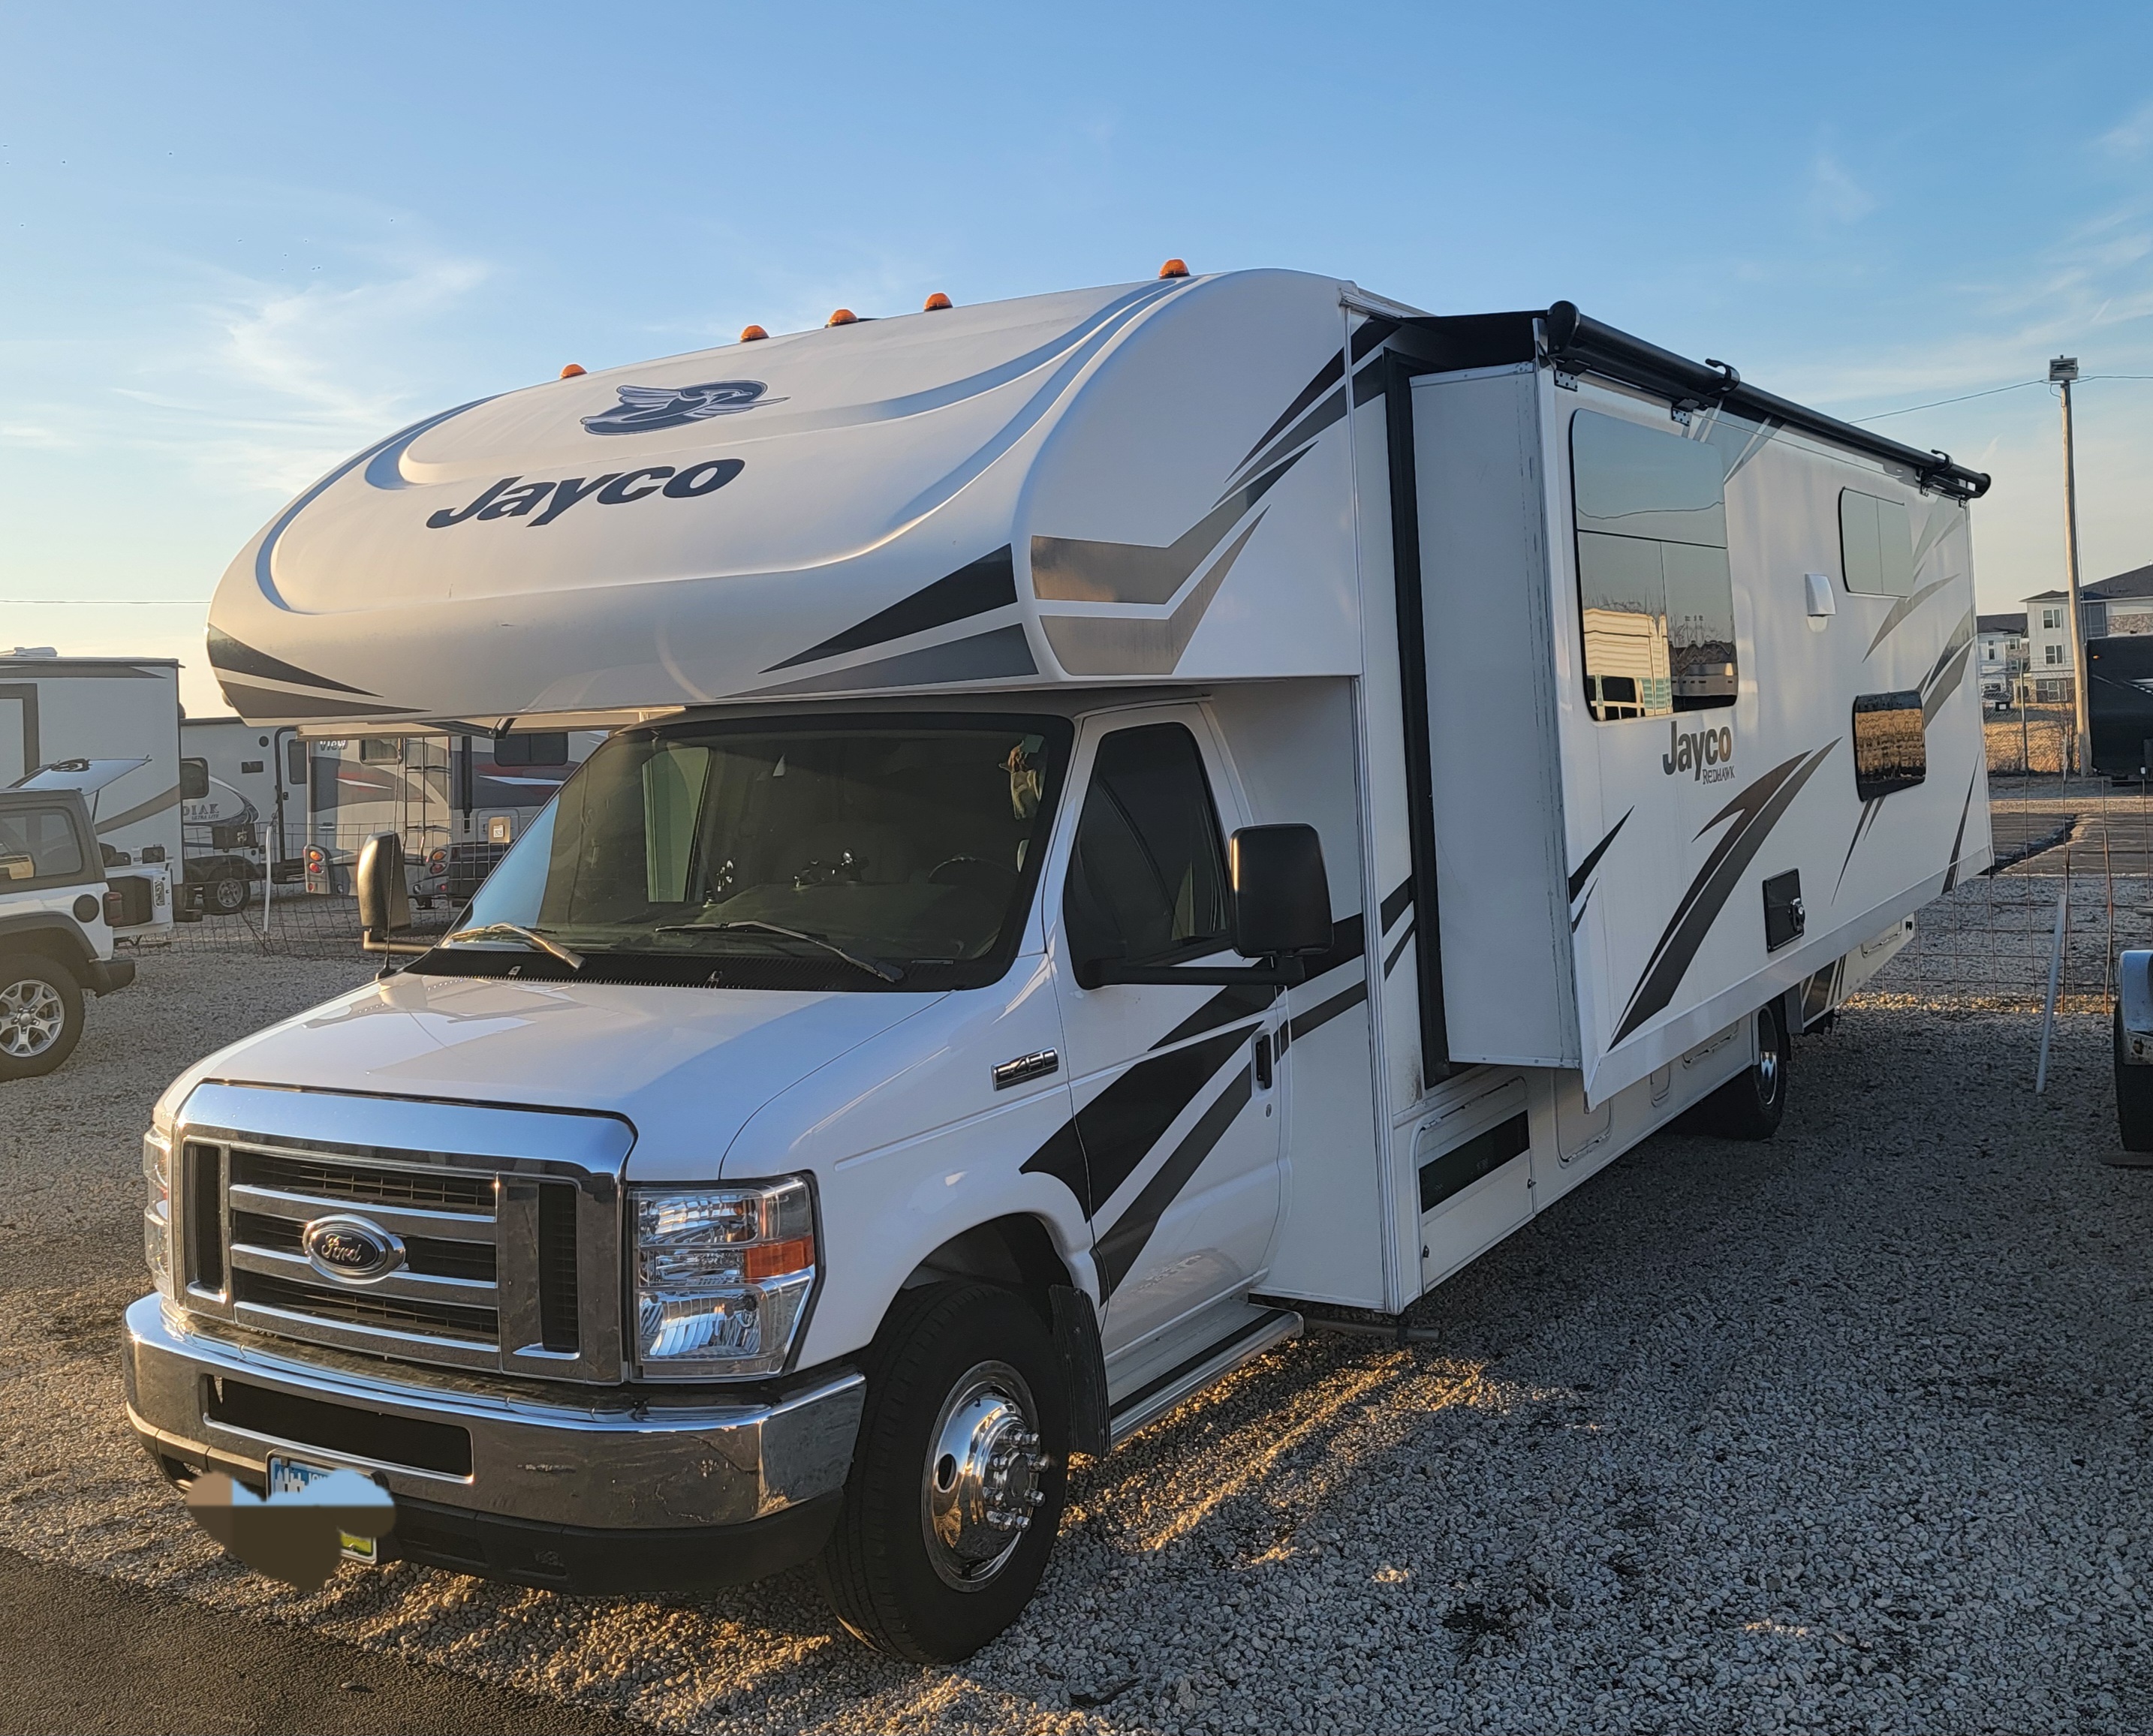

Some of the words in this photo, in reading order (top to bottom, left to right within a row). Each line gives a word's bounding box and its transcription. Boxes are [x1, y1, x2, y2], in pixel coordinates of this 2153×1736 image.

[426, 459, 745, 528] Jayco
[1662, 721, 1732, 781] Jayco
[321, 1233, 362, 1262] Ford
